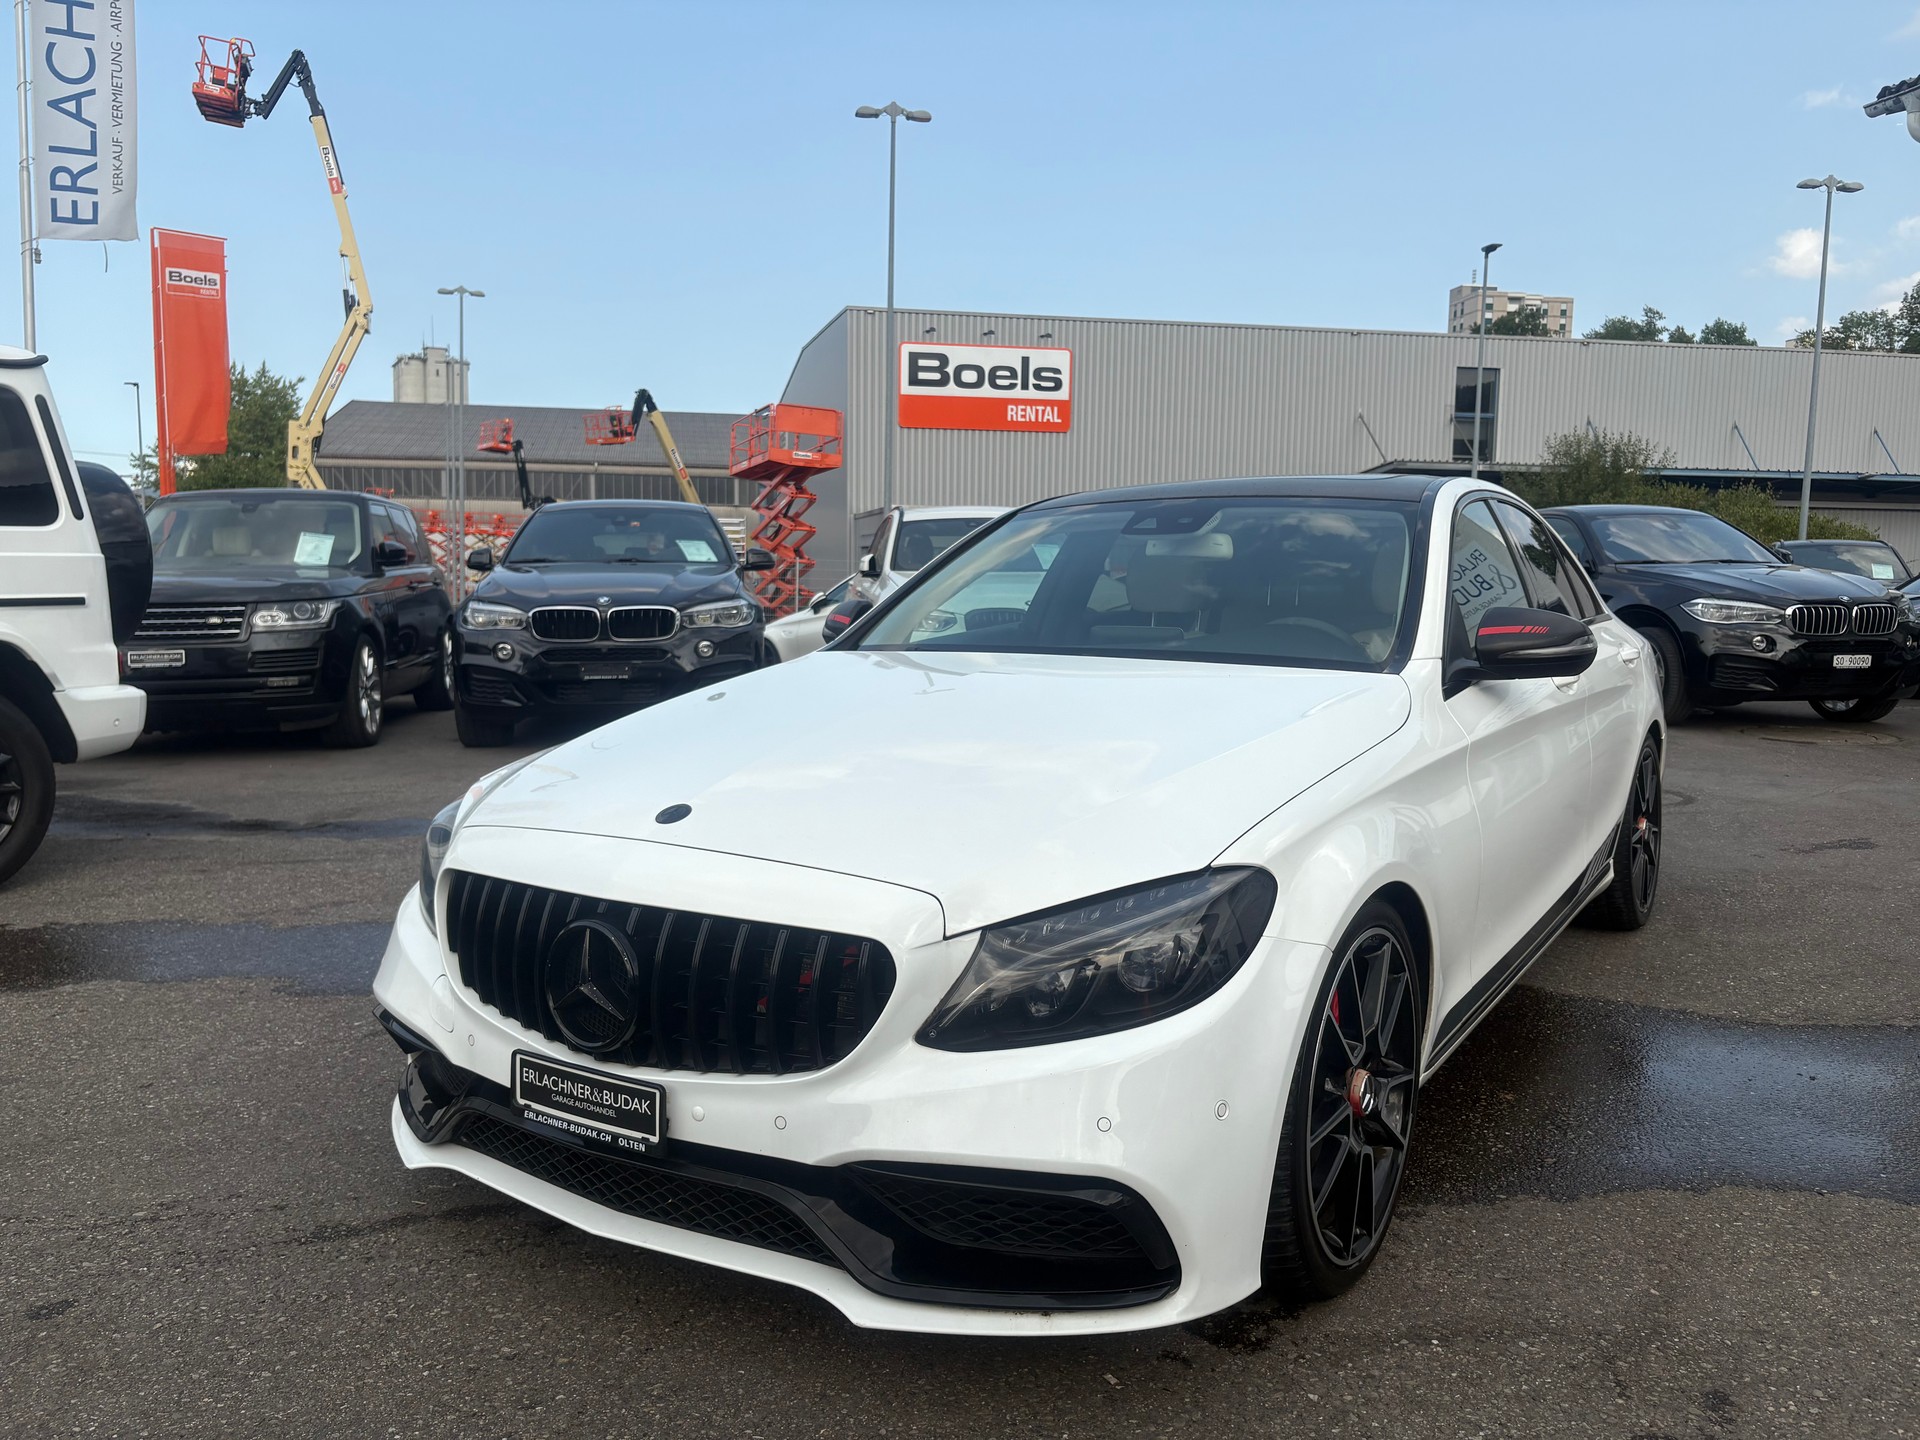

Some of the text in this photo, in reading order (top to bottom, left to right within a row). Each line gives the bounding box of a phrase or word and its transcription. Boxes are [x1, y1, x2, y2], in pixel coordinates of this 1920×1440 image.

[45, 0, 98, 225] ERLACH
[109, 0, 124, 195] VERKAUF VERMIETUNG AIRP
[168, 270, 218, 287] Boels
[908, 351, 1063, 392] Boels
[1007, 405, 1062, 423] RENTAL
[551, 1093, 617, 1118] GARAGE AUTOHANDEL
[523, 1109, 646, 1152] ERLACHNER-BUDAK.CH OLTEN
